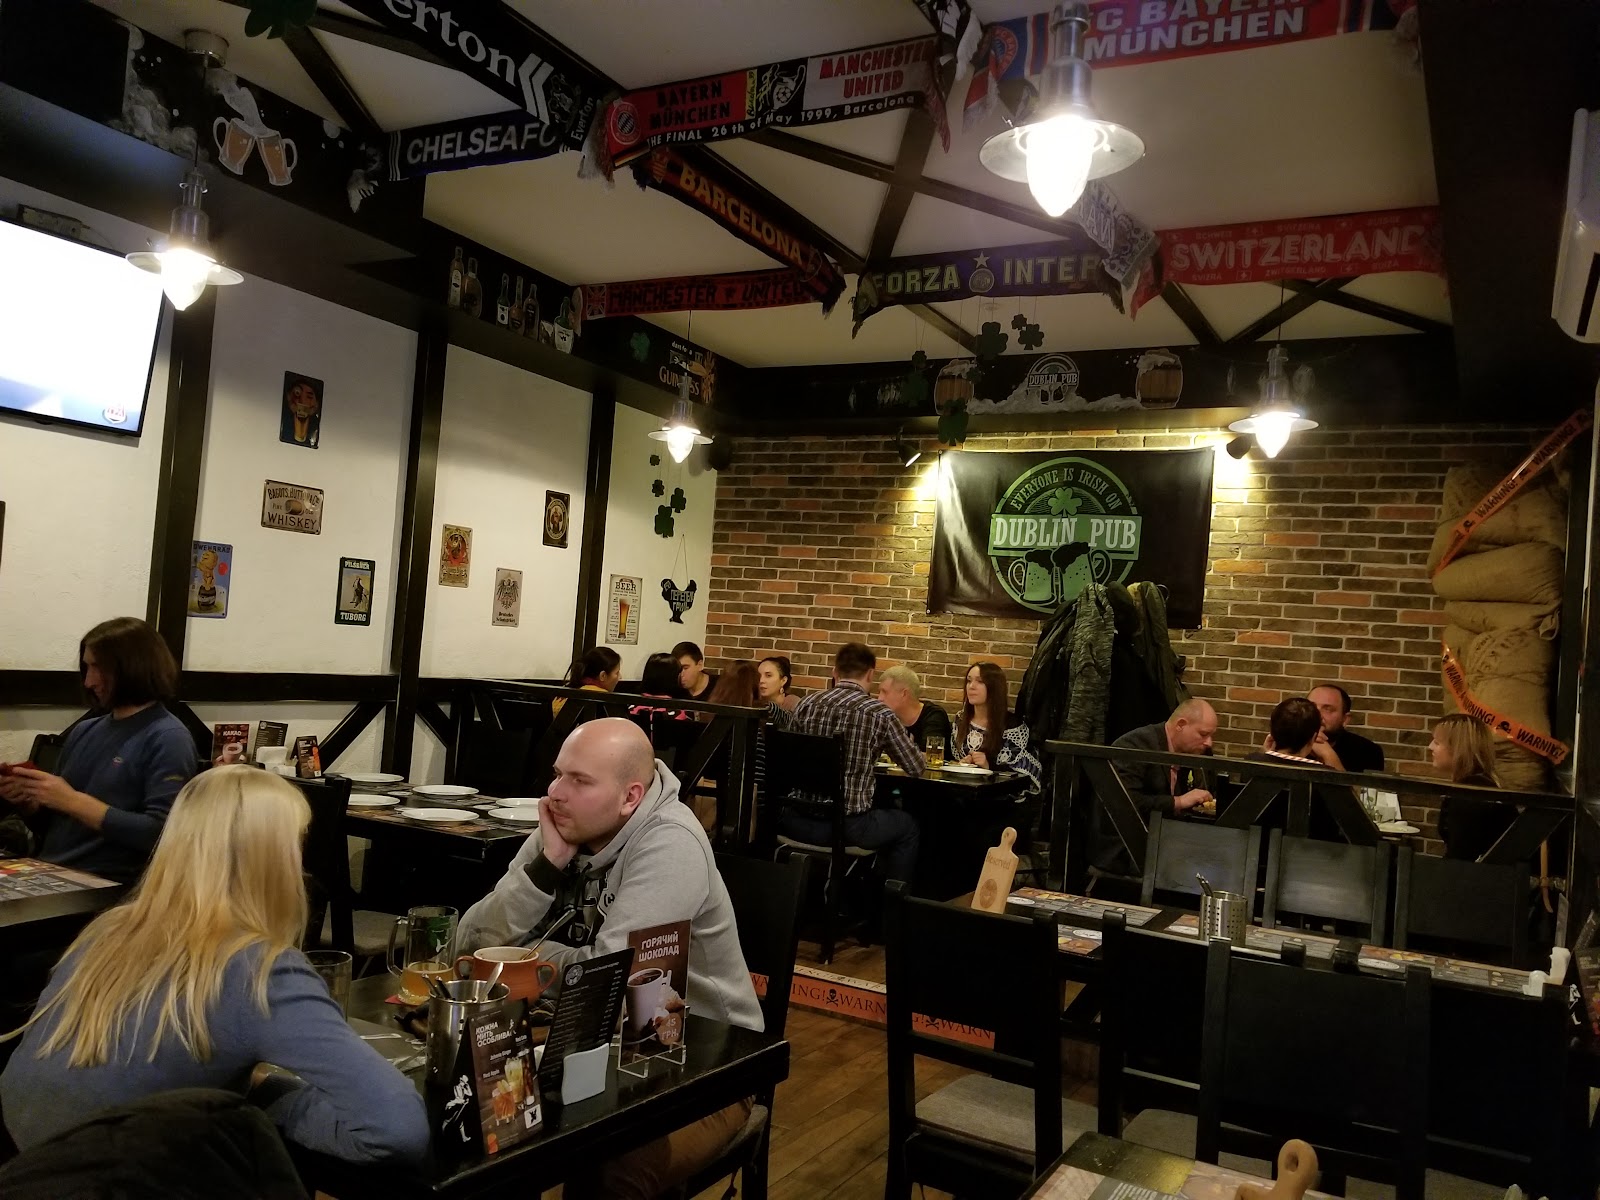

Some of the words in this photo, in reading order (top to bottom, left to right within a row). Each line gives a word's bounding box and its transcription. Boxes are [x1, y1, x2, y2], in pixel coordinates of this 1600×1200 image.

[1082, 6, 1305, 60] MÜNCHEN
[656, 80, 723, 108] BAYERN
[843, 70, 903, 98] UNITED
[570, 97, 594, 142] Everton
[650, 102, 731, 130] MÜNCHEN
[666, 130, 703, 143] FINAL
[711, 124, 728, 138] 26
[732, 123, 745, 134] th
[750, 116, 763, 130] of
[766, 112, 792, 125] May
[801, 107, 838, 121] 1999,
[844, 95, 915, 116] Barcelona
[406, 125, 519, 164] CHELSEA
[520, 122, 556, 148] FC
[679, 162, 803, 266] BARCELONA
[874, 264, 961, 295] FORZA
[1002, 254, 1102, 286] INTER
[609, 284, 717, 307] MANCHESTER
[1029, 374, 1058, 385] DUBLIN
[1061, 373, 1078, 383] PUB
[1474, 478, 1519, 519] WARNING!
[1532, 423, 1577, 466] WARNING!
[1010, 469, 1059, 511] EVERYONE
[1063, 468, 1075, 481] IS
[1078, 469, 1110, 496] IRISH
[1105, 492, 1123, 511] ON
[267, 511, 317, 530] WHISKEY
[993, 517, 1078, 547] DUBLIN
[1087, 518, 1137, 549] PUB
[615, 581, 637, 592] BEER
[340, 612, 367, 622] TUBORG
[1517, 728, 1565, 759] WARNING!
[638, 945, 680, 962] ШОКОЛАД
[641, 931, 679, 950] ГОРЯЧИЙ
[476, 1021, 499, 1035] КОЖНА
